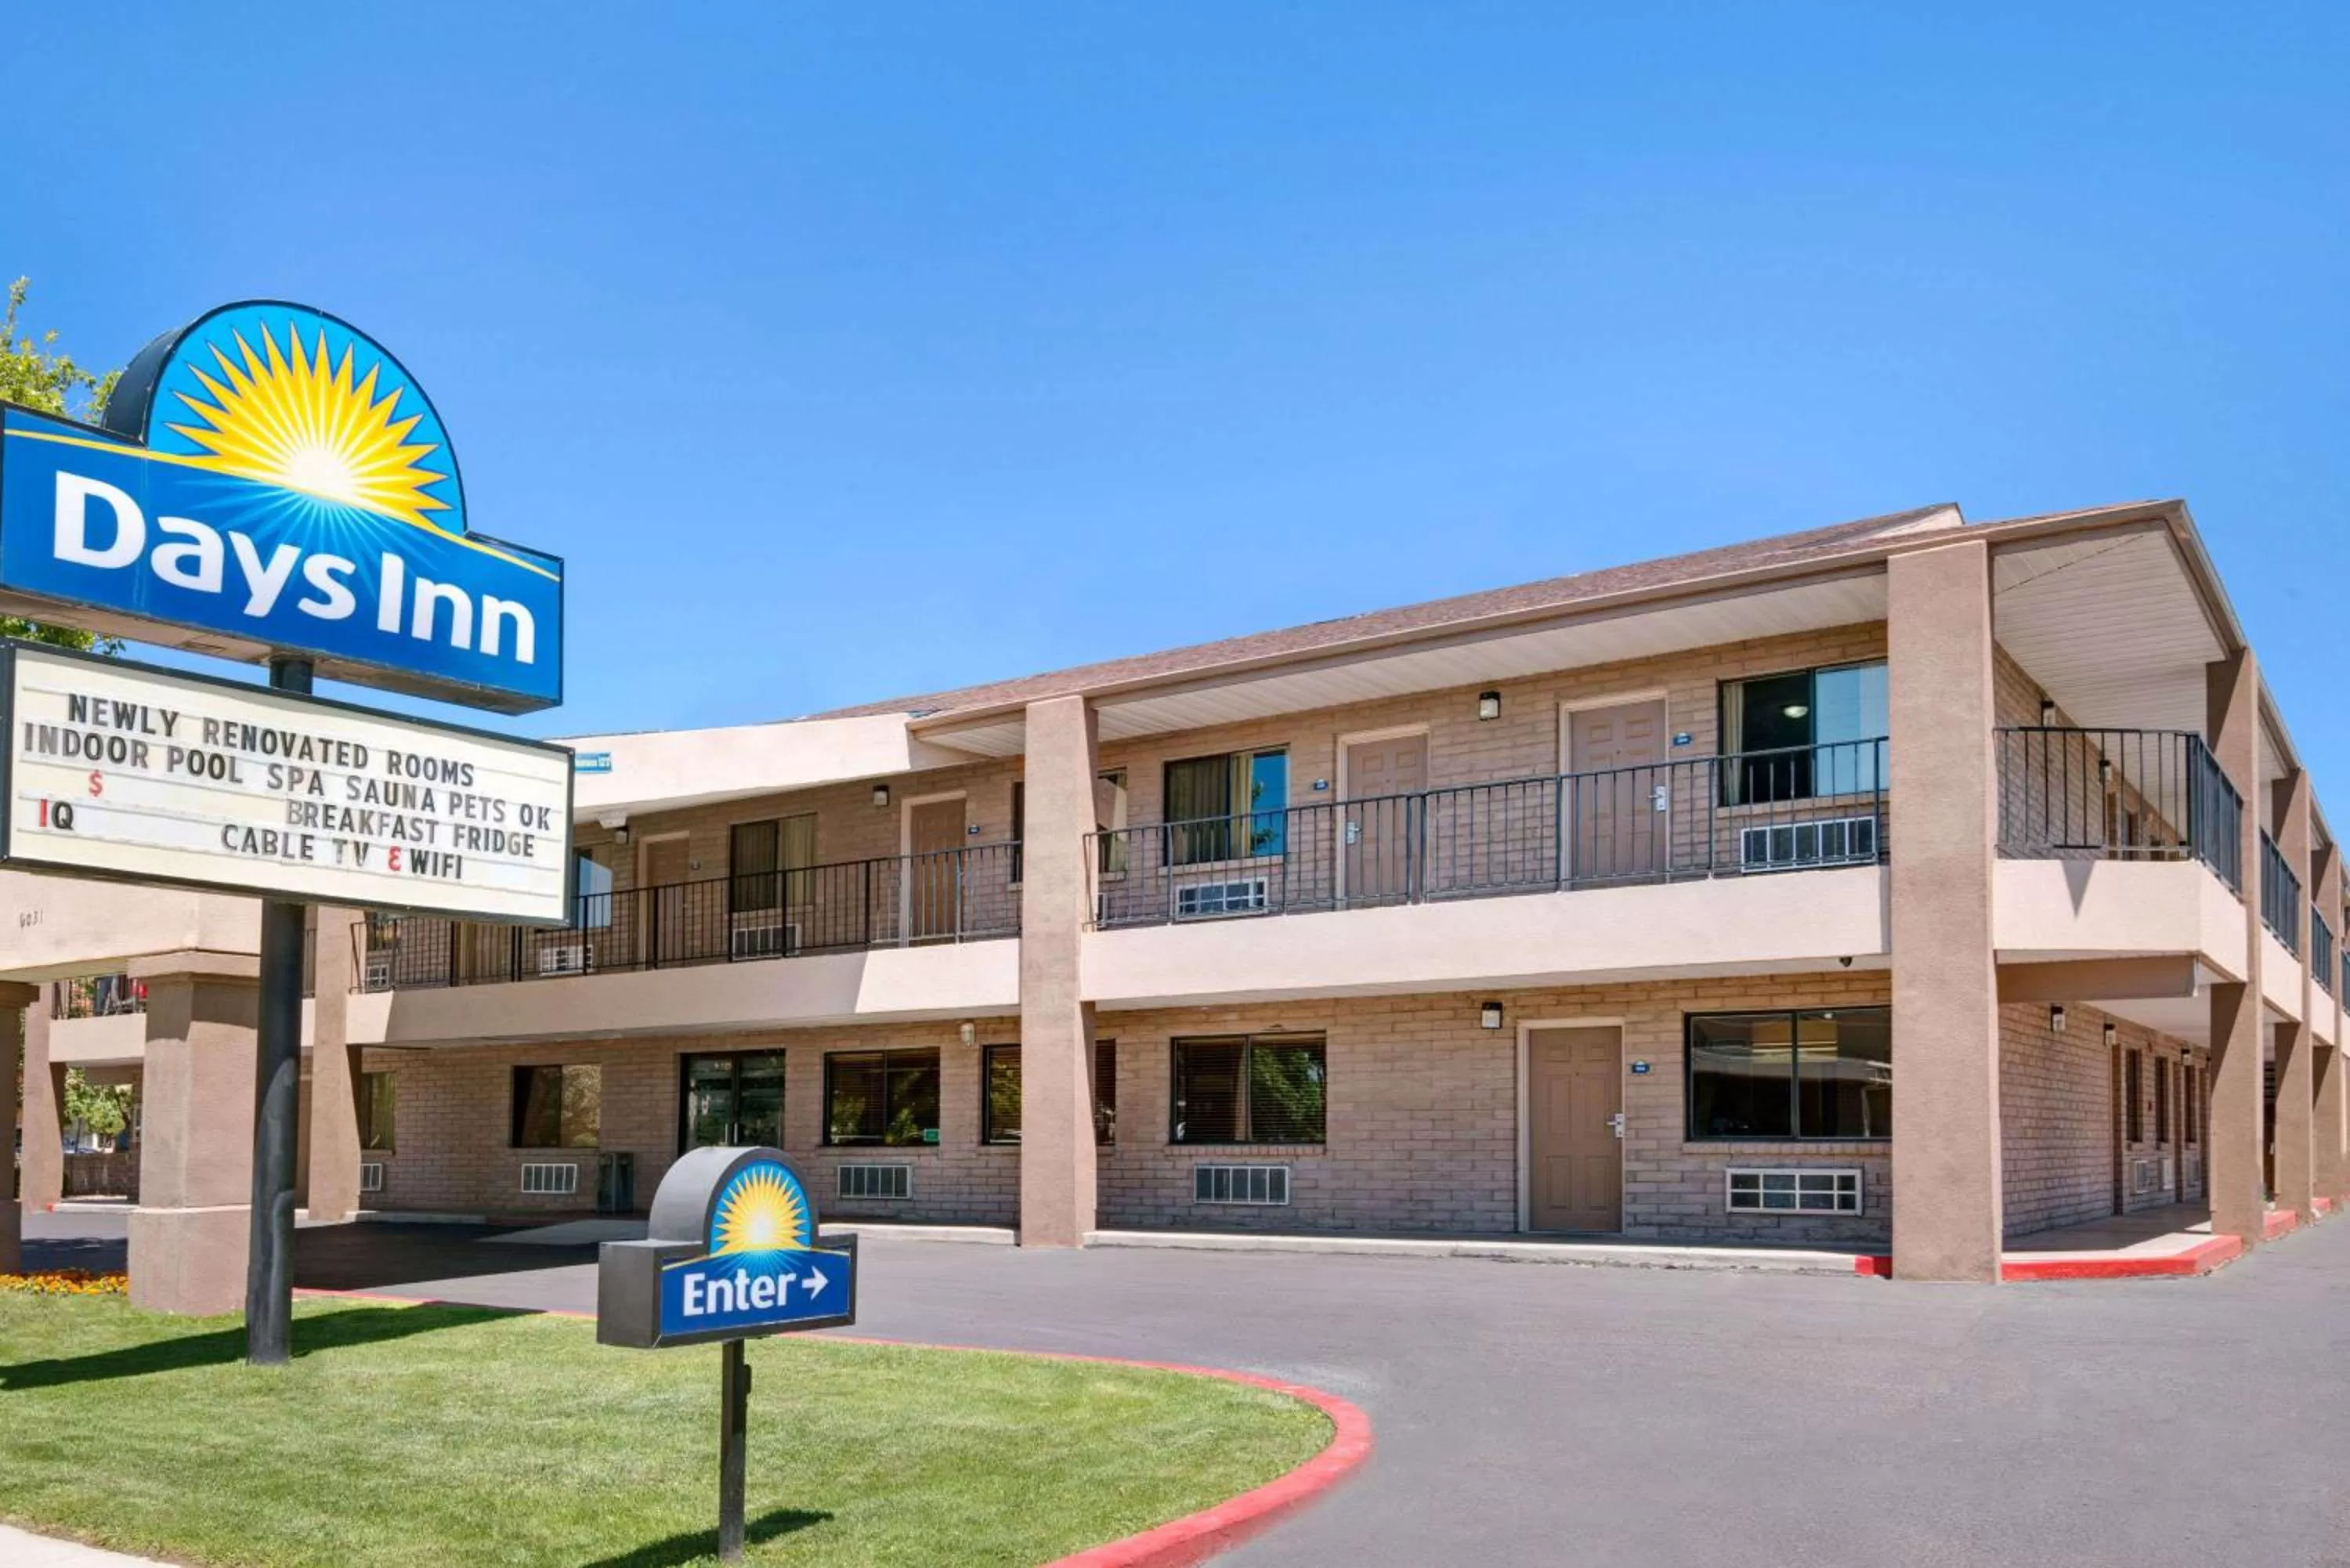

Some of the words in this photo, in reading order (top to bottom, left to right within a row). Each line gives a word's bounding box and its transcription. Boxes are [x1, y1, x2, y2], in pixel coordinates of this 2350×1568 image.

[53, 468, 357, 621] Days
[377, 551, 536, 664] Inn
[67, 693, 180, 737] NEWLY
[203, 717, 368, 770] RENOVATED
[387, 750, 474, 787] ROOMS
[24, 722, 149, 769] INDOOR
[166, 746, 243, 784] POOL
[266, 763, 324, 797] SPA
[346, 775, 436, 813] SAUNA
[448, 791, 506, 823] PETS
[519, 804, 551, 830] OK
[89, 769, 103, 797] $
[221, 823, 314, 861] CABLE
[332, 837, 370, 867] TV
[410, 848, 464, 879] WIFI
[287, 799, 439, 844] BREAKFAST
[453, 823, 536, 858] FRIDGE
[683, 1269, 797, 1317] Enter
